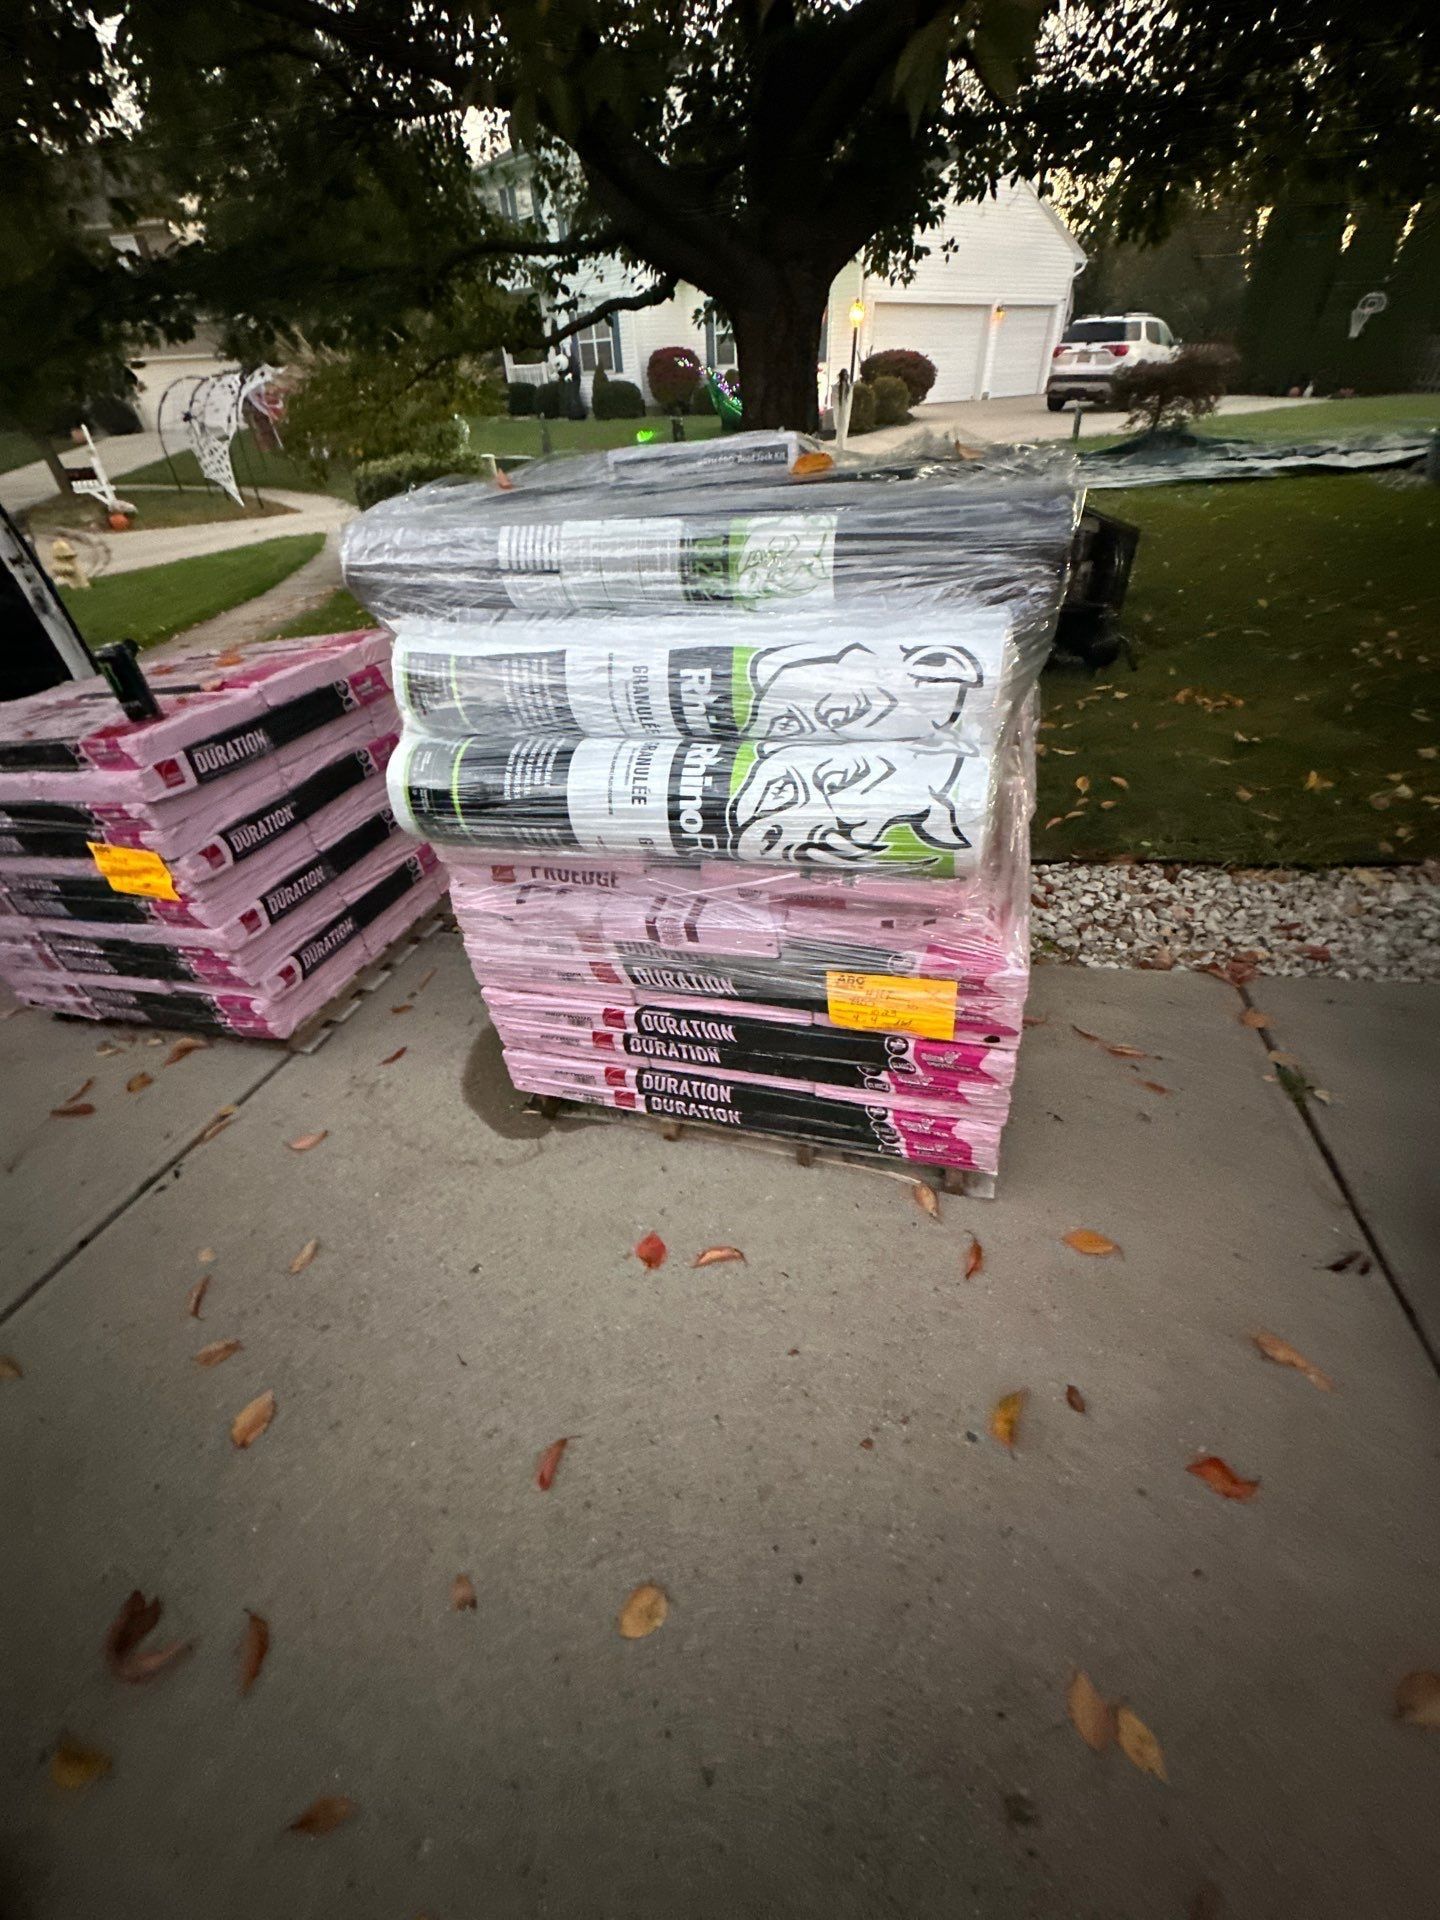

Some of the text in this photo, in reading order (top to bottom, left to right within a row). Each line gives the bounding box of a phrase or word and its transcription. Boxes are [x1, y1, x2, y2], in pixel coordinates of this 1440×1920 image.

[193, 728, 267, 774] DURATION
[230, 804, 295, 853] DURATION
[266, 865, 326, 915] DURATION
[301, 917, 354, 970] DURATION
[632, 966, 739, 996] DURATION
[641, 1013, 738, 1043] DURATION
[629, 1036, 722, 1064] DURATION
[642, 1073, 733, 1104] DURATION
[651, 1096, 742, 1125] DURATION
